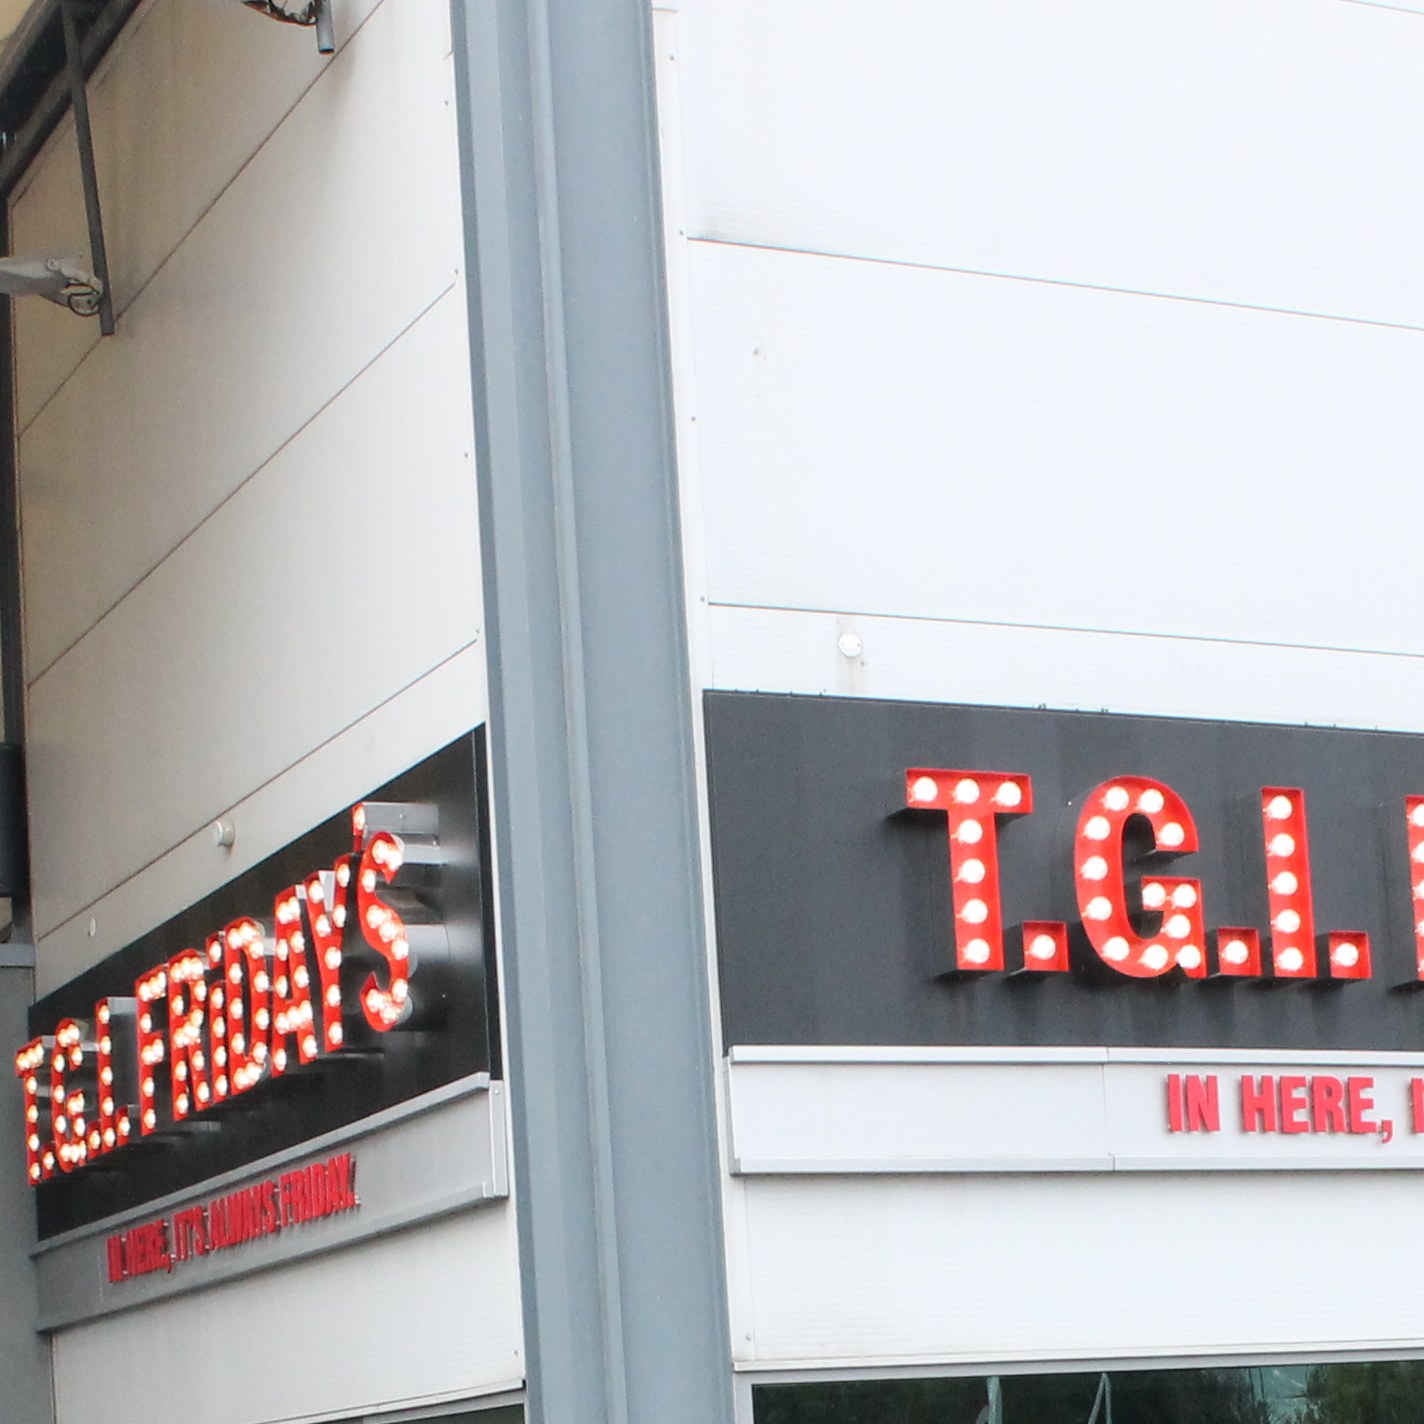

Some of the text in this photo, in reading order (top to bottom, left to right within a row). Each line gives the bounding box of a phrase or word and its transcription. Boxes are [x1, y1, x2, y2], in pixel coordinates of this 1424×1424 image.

[904, 767, 1374, 981] T.G.I.
[1164, 1073, 1222, 1133] IN
[1240, 1074, 1394, 1144] HERE,
[207, 1179, 277, 1251] ALWAYS
